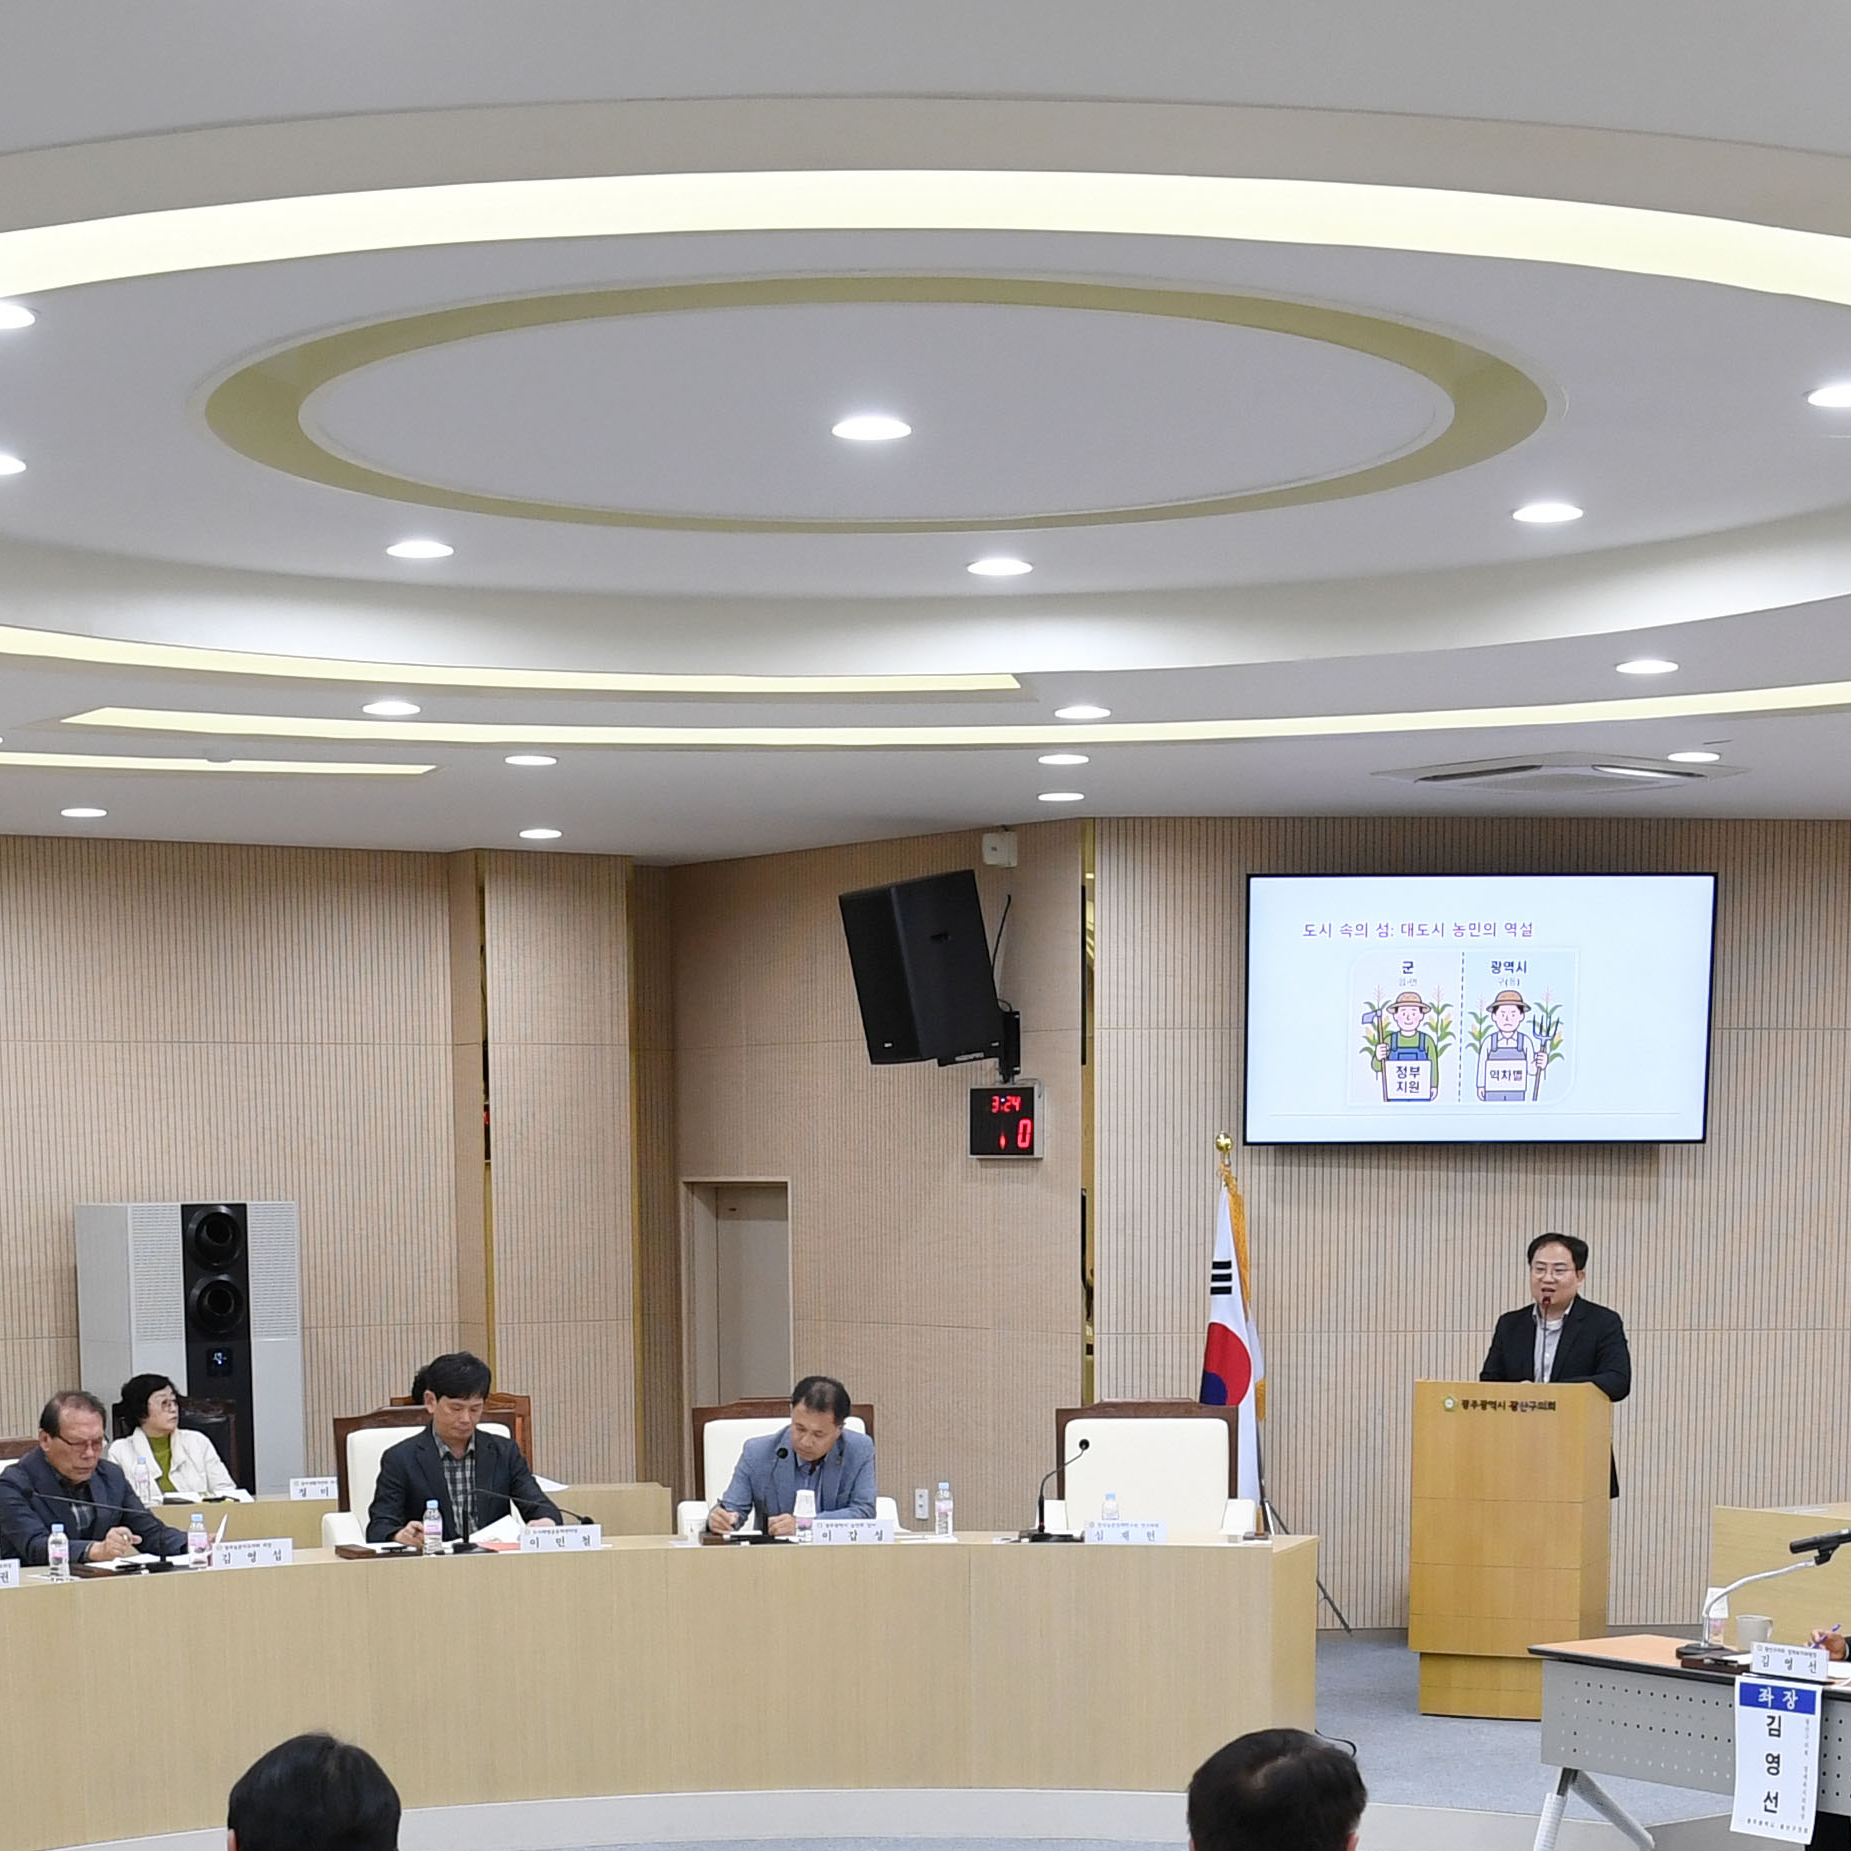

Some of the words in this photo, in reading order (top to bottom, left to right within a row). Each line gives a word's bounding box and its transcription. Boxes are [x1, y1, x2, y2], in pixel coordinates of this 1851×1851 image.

[1302, 922, 1332, 938] 도시
[1340, 922, 1368, 938] 속의
[1376, 921, 1394, 938] 섬:
[1400, 921, 1445, 938] 대도시
[1452, 921, 1496, 938] 농민의
[1503, 921, 1534, 938] 역설
[1402, 960, 1415, 975] 군
[1490, 960, 1528, 975] 광역시
[1396, 1065, 1421, 1079] 정부
[1396, 1079, 1421, 1094] 지원
[1761, 1654, 1770, 1668] 김
[1757, 1686, 1774, 1708] 좌
[1782, 1689, 1798, 1710] 장
[1766, 1715, 1781, 1738] 김
[1765, 1753, 1780, 1776] 영
[1763, 1790, 1779, 1814] 선
